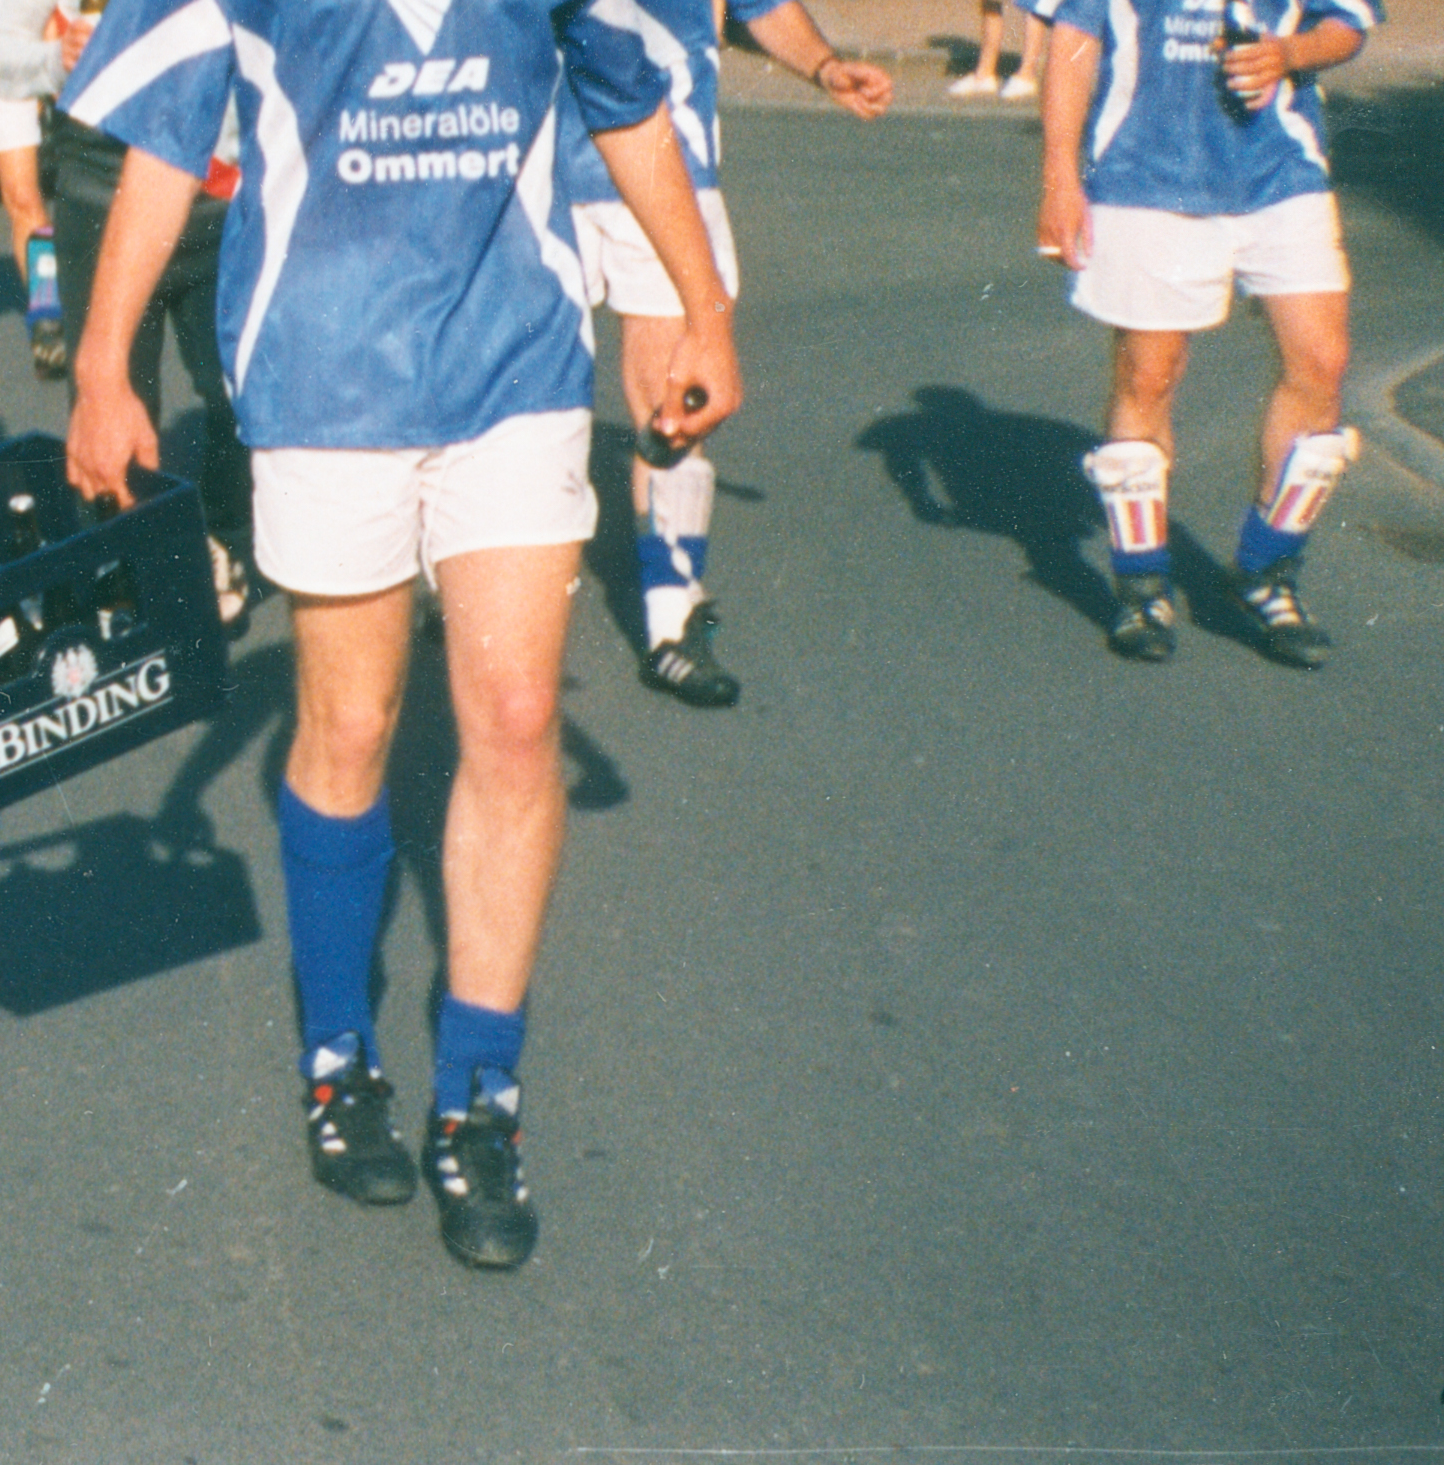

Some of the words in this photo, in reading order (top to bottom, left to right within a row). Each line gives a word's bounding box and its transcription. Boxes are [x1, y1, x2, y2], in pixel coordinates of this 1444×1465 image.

[367, 56, 490, 99] DEA
[339, 102, 520, 143] Mineralöle
[337, 142, 520, 184] Ommert
